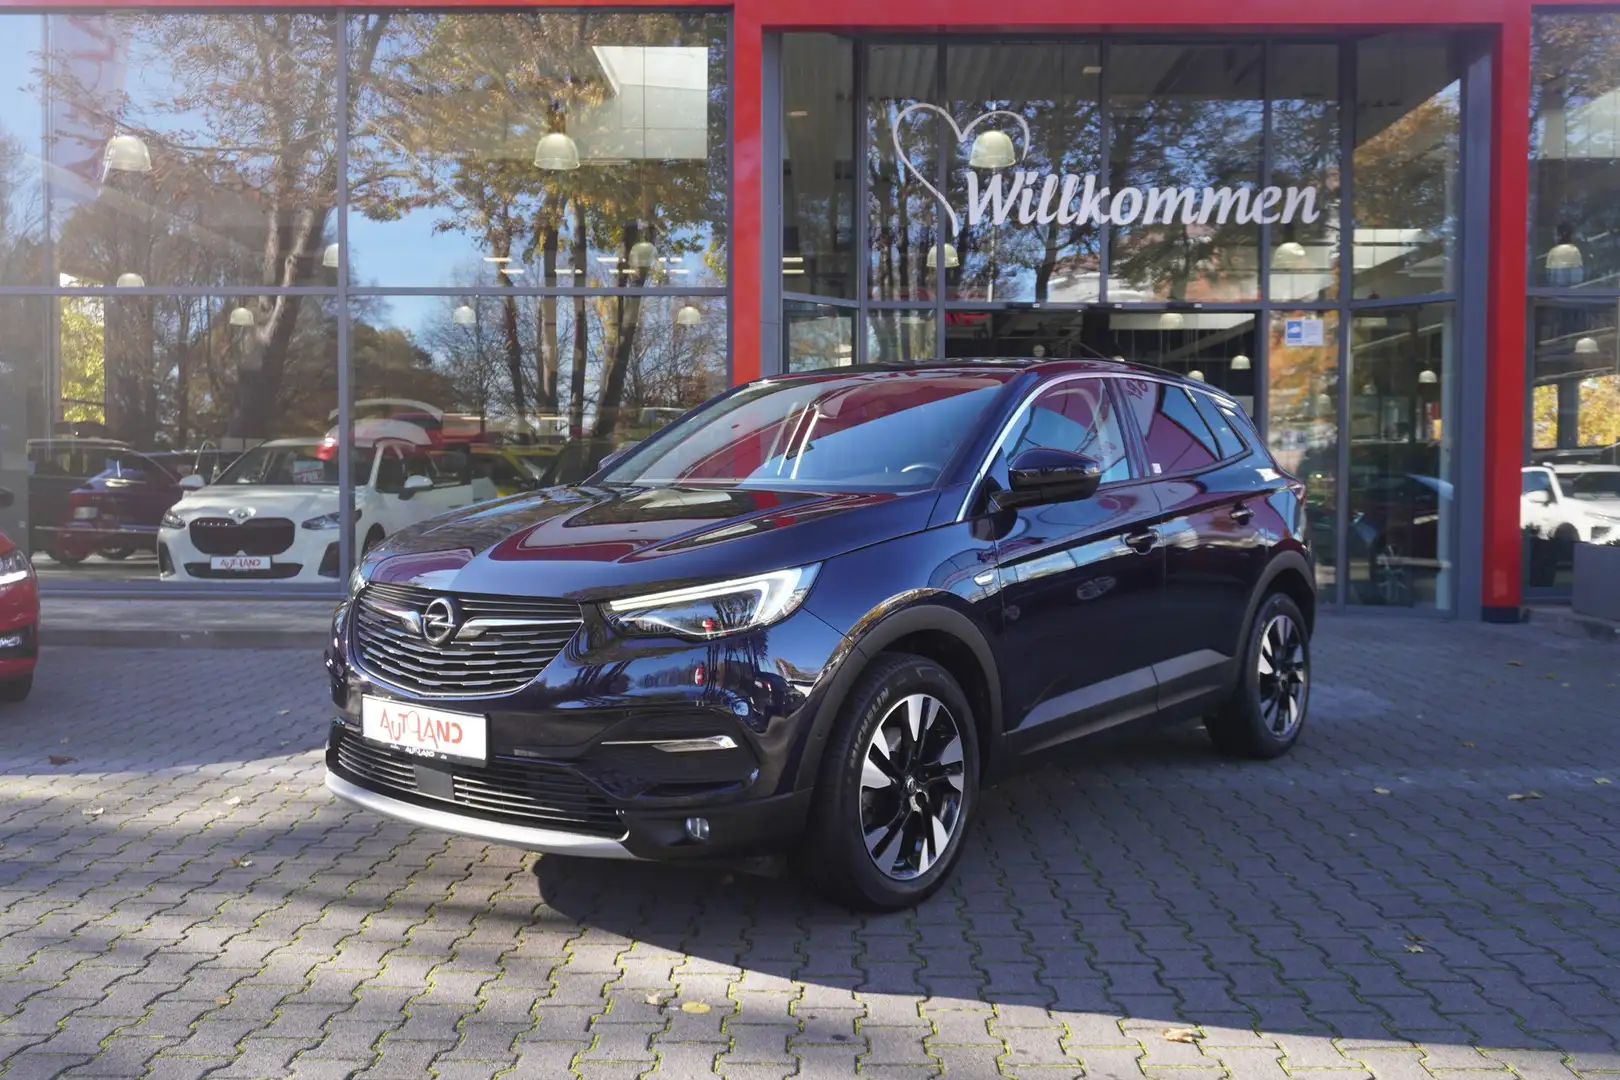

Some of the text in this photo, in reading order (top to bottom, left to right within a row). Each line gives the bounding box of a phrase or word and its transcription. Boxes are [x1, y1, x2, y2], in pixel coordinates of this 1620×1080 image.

[966, 171, 1320, 225] Willkommen
[220, 558, 261, 569] AUTLAND
[380, 707, 463, 749] AUTOLAND
[850, 687, 890, 769] MICHELIN
